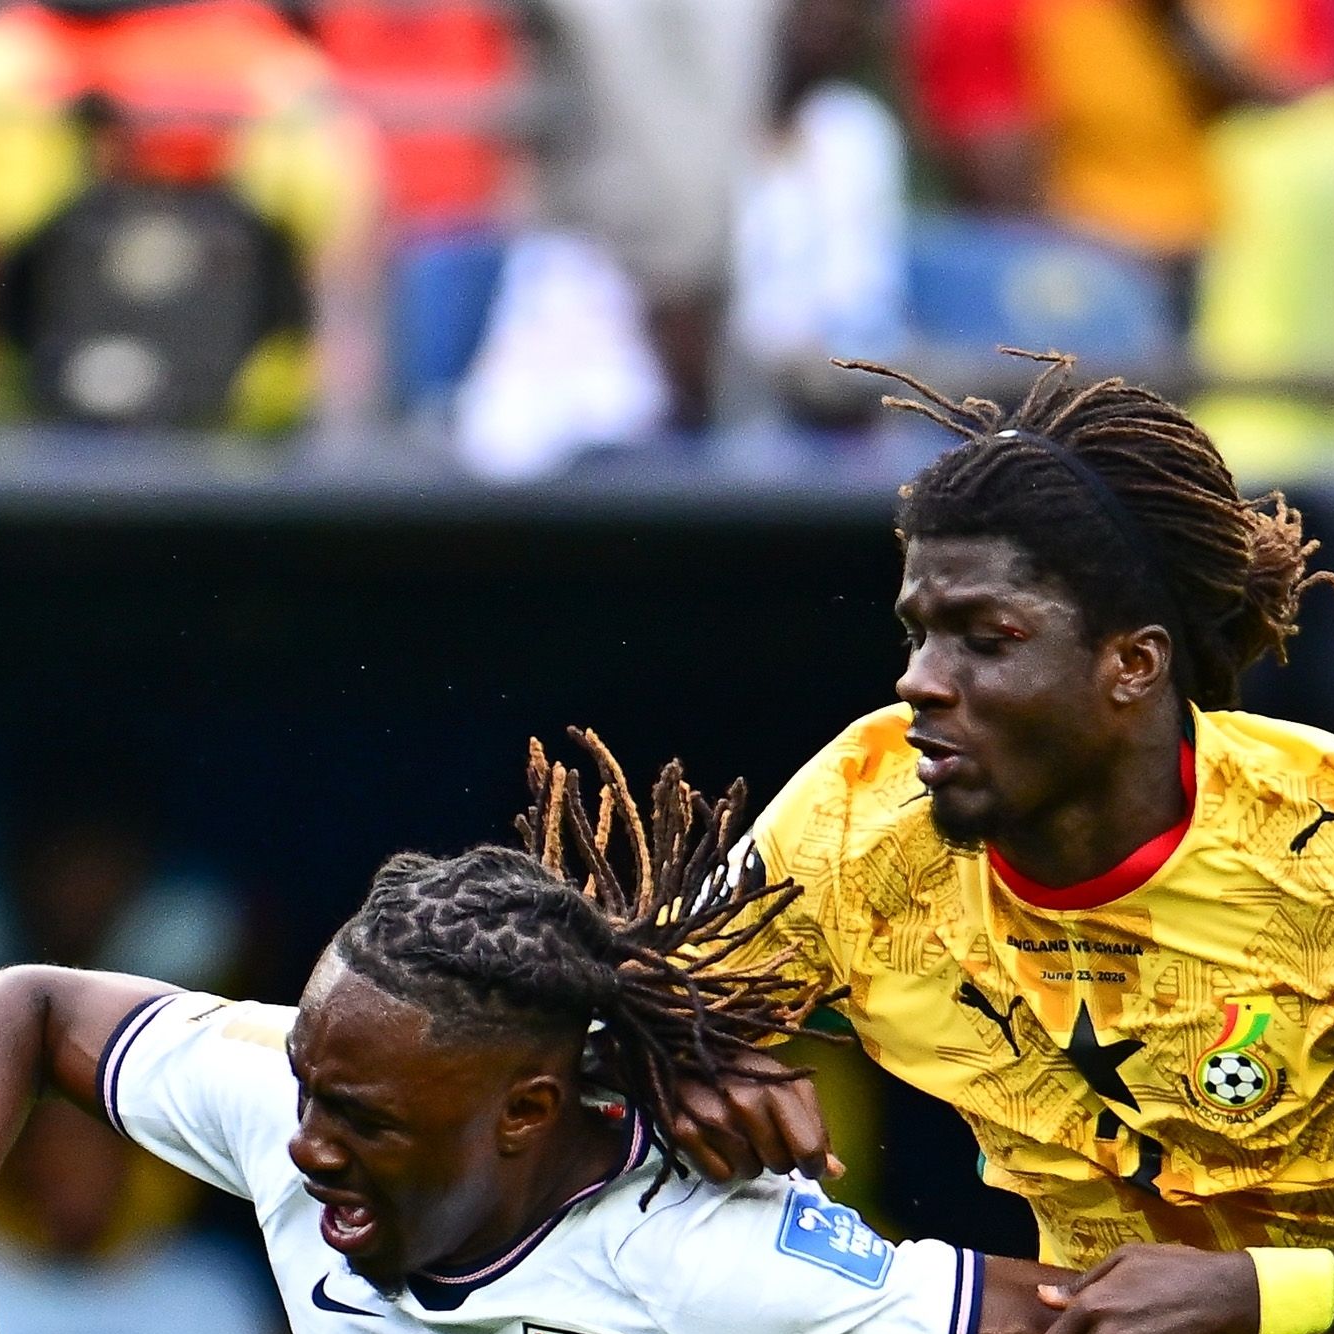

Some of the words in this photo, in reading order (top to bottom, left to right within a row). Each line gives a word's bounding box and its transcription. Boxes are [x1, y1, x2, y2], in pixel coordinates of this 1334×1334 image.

[1006, 935, 1069, 951] ENGLAND
[1072, 939, 1090, 952] VS
[1093, 941, 1144, 956] GHANA
[1040, 970, 1073, 981] June
[1097, 971, 1127, 983] 2026
